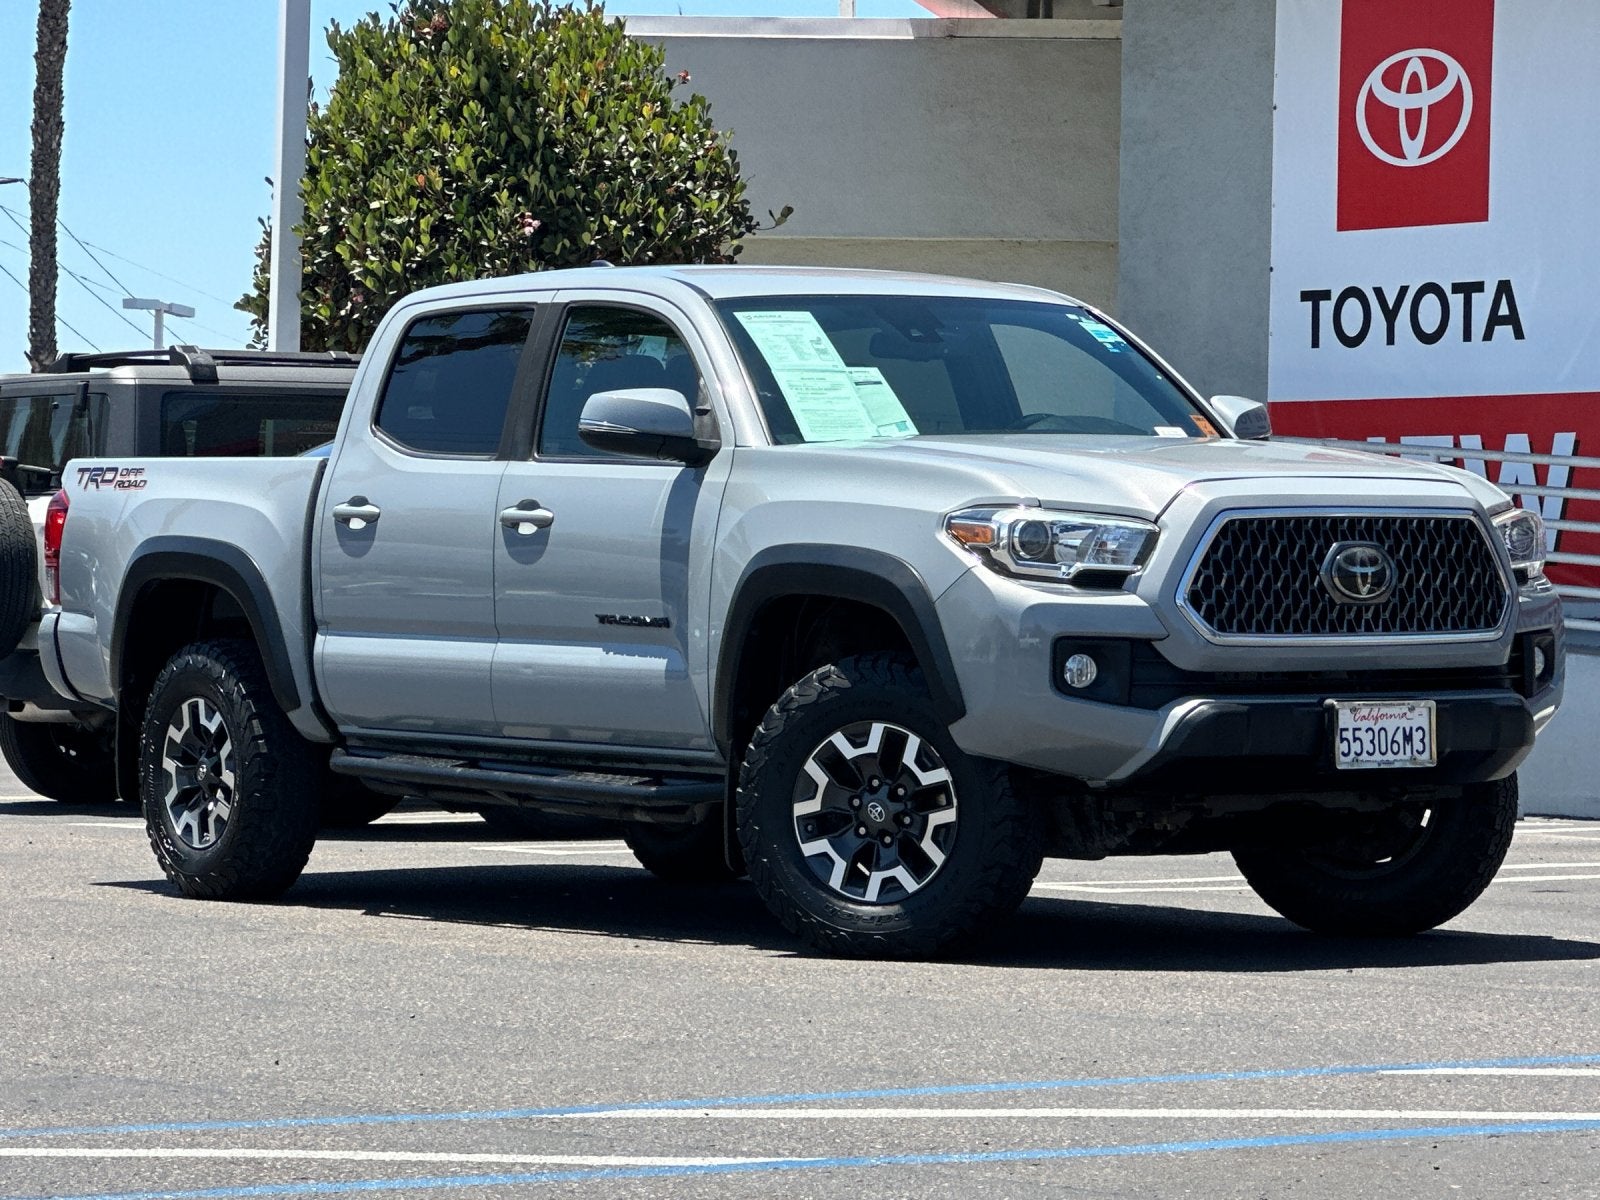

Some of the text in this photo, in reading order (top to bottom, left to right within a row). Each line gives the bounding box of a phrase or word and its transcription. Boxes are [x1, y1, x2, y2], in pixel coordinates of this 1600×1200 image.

[1300, 279, 1525, 349] TOYOTA
[77, 467, 145, 490] TRD OFF
[114, 479, 148, 490] ROAD
[1353, 707, 1414, 725] California
[1339, 726, 1427, 757] 55306M3
